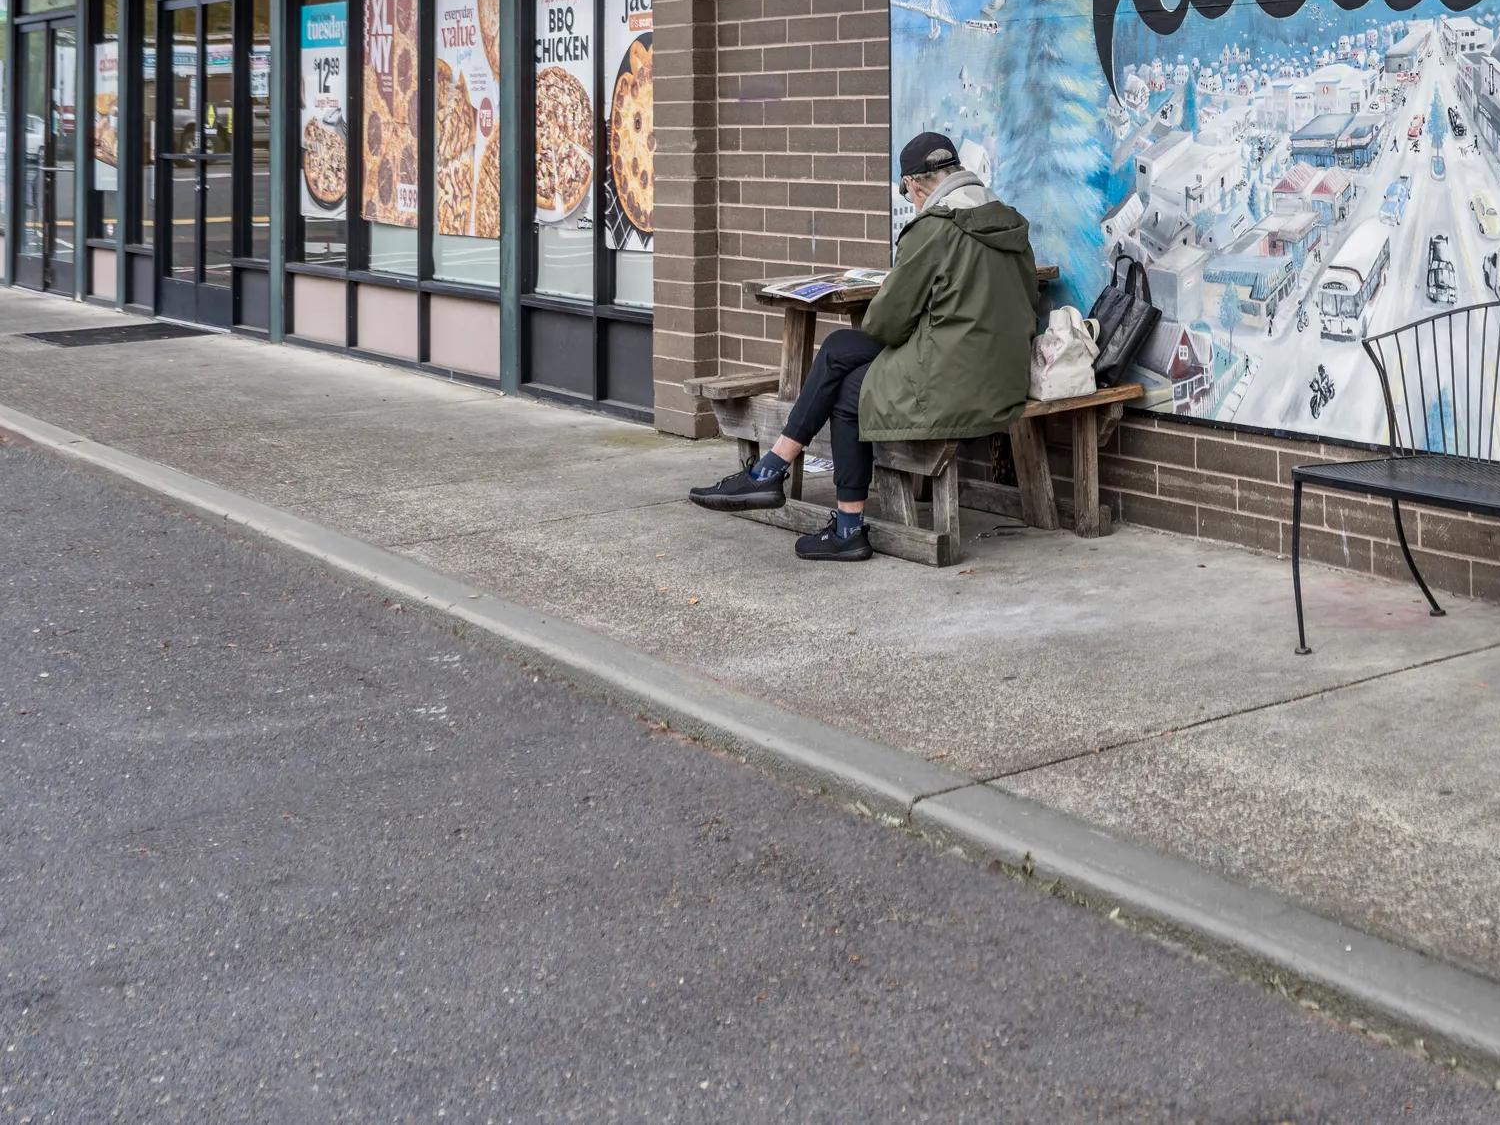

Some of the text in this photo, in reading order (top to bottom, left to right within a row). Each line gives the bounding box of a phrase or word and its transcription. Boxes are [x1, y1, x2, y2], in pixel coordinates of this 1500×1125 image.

[444, 4, 475, 22] everyday
[548, 6, 575, 35] BBQ
[306, 14, 347, 45] tuesday
[441, 19, 477, 49] value
[370, 35, 393, 74] NY
[534, 35, 589, 64] CHICKEN
